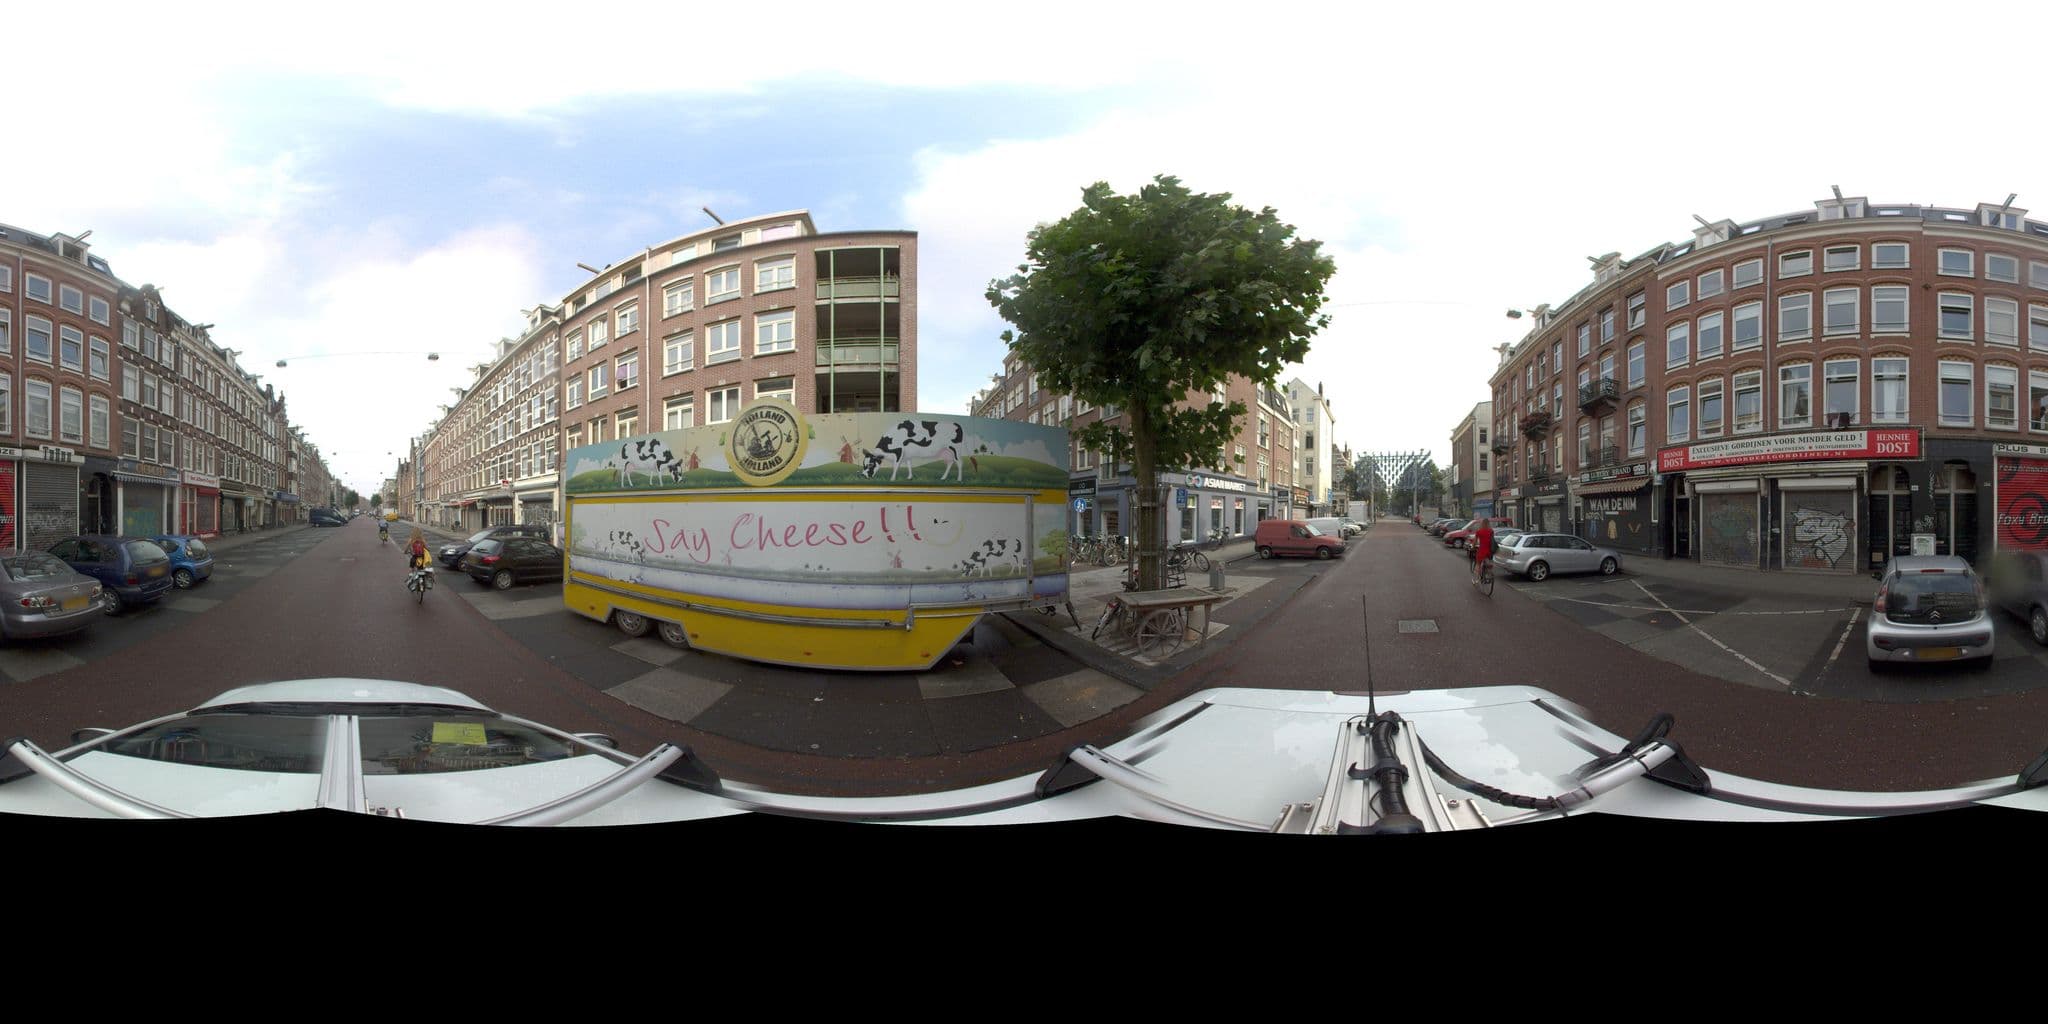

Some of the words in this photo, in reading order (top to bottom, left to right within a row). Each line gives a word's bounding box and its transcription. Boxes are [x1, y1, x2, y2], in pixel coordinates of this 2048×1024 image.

[1732, 439, 1772, 450] GORDIJNEN
[1774, 437, 1796, 446] VOOR
[1798, 434, 1832, 444] MINDER
[1834, 434, 1856, 442] GELD
[1876, 433, 1910, 441] HENNIE
[1876, 442, 1911, 454] DOST
[1998, 445, 2028, 453] PLUS
[1663, 458, 1684, 468] DOST
[1203, 477, 1225, 489] ASIAN
[1225, 479, 1246, 492] MARKET
[1590, 498, 1609, 511] WAM
[1611, 497, 1637, 511] DENIM
[644, 518, 711, 563] Say
